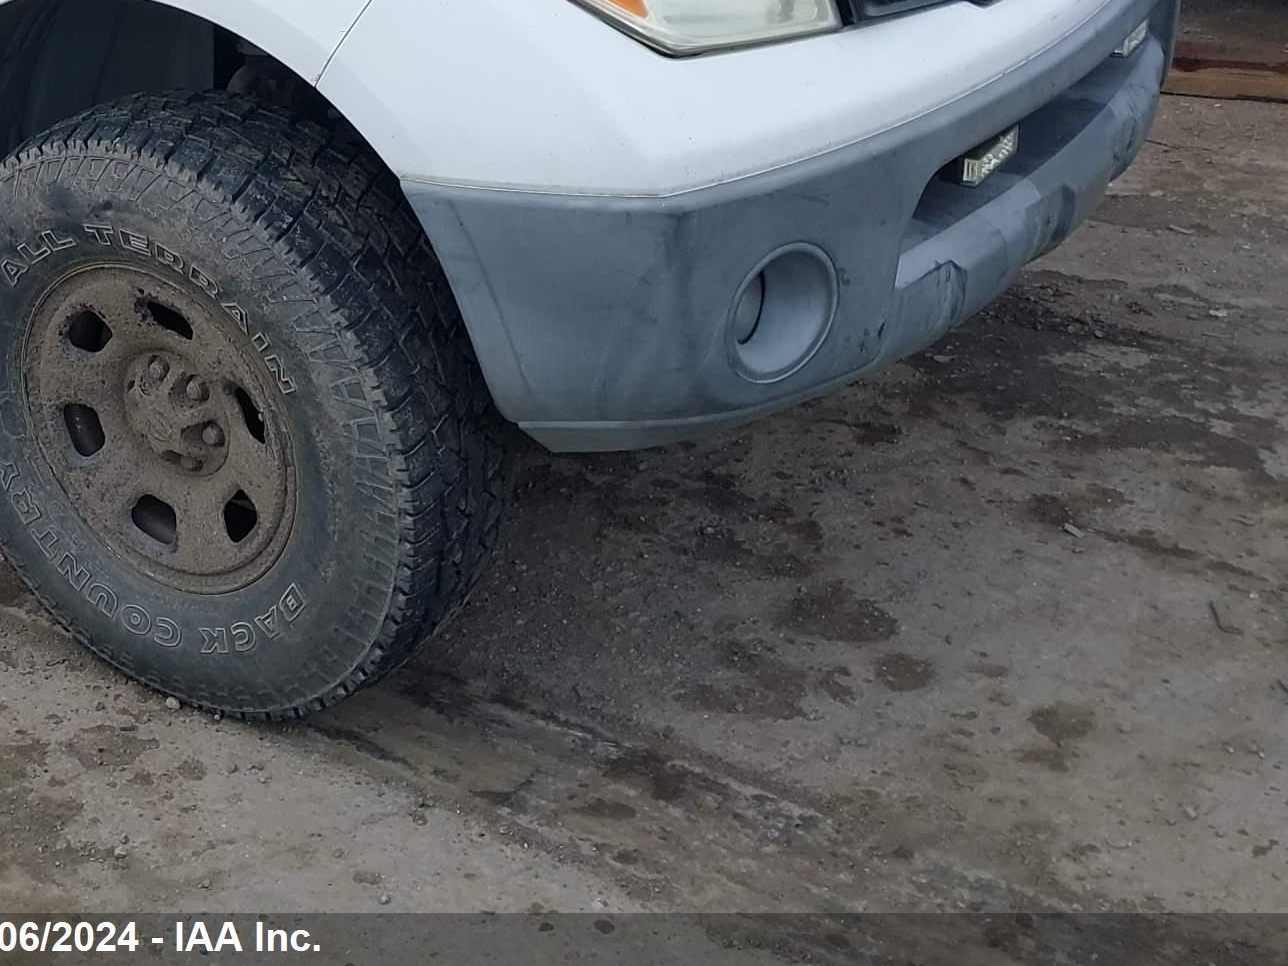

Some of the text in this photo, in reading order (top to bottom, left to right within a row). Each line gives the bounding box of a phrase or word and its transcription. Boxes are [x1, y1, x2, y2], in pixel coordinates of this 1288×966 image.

[1, 223, 297, 395] ALL TERRAIN
[199, 582, 307, 654] BACK
